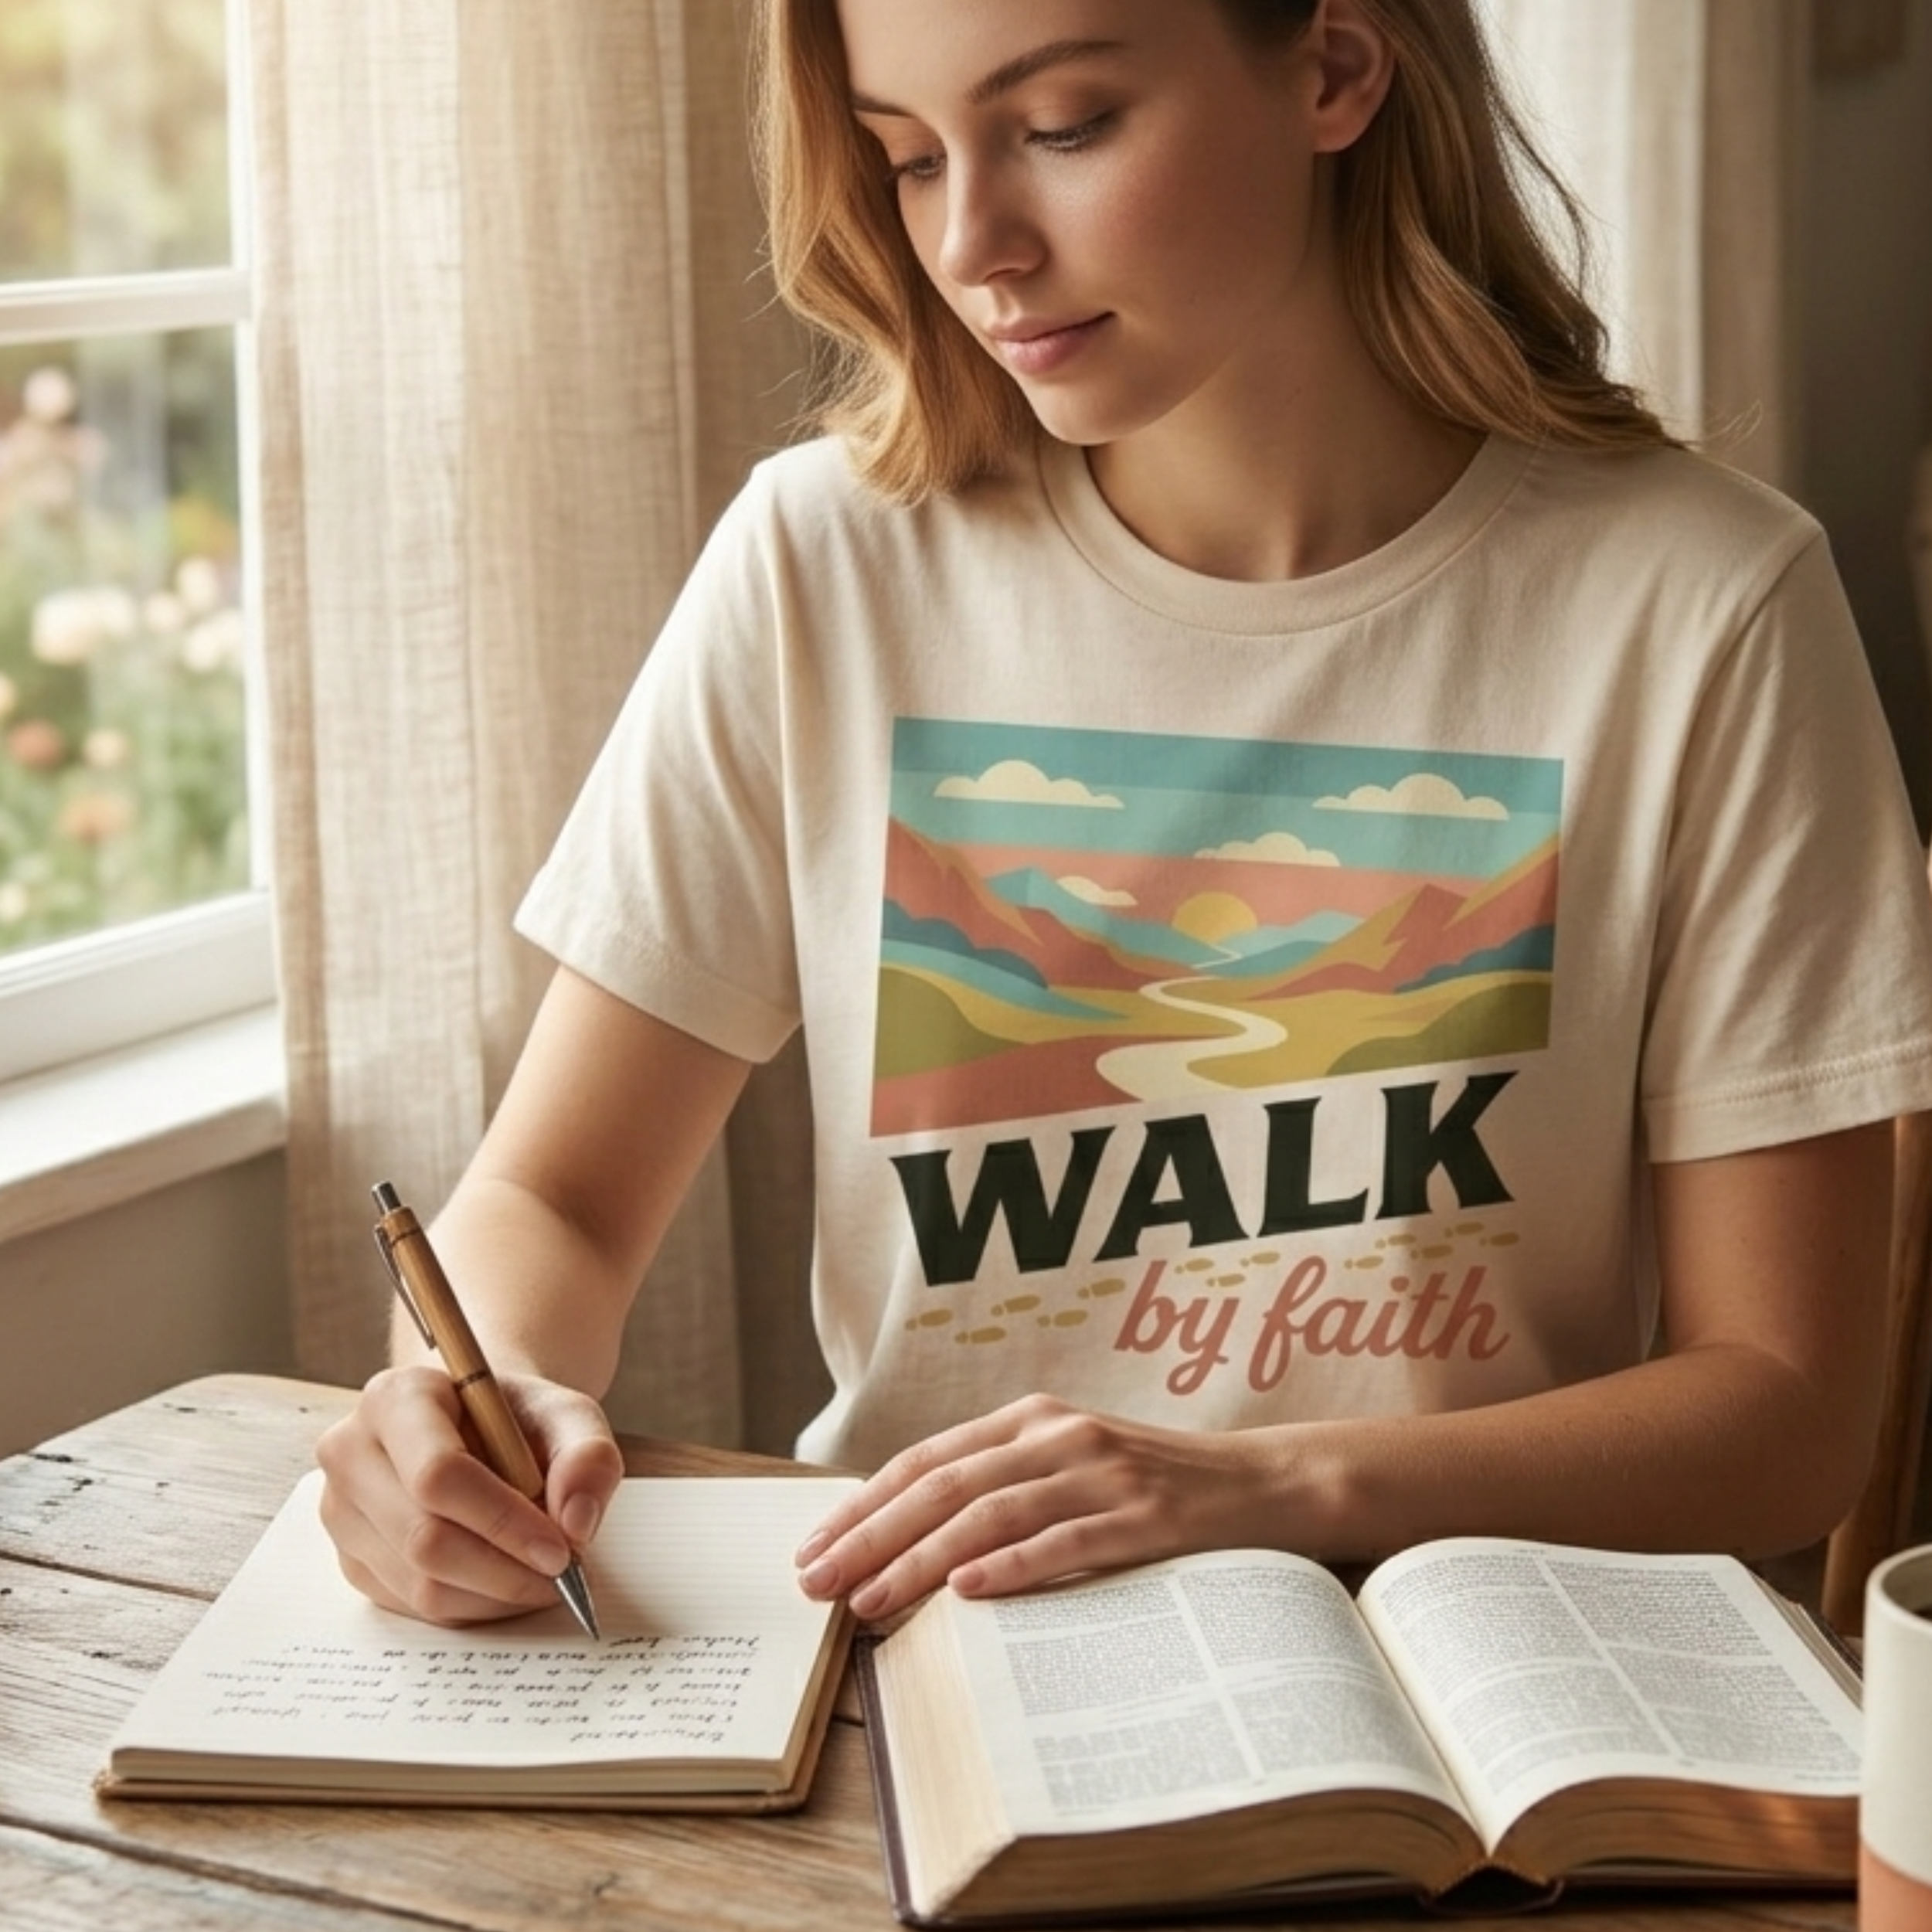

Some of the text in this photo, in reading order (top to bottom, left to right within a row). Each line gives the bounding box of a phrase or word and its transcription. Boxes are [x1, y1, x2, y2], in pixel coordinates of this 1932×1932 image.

[889, 1070, 1519, 1287] WALK
[1114, 1255, 1510, 1396] by faith
